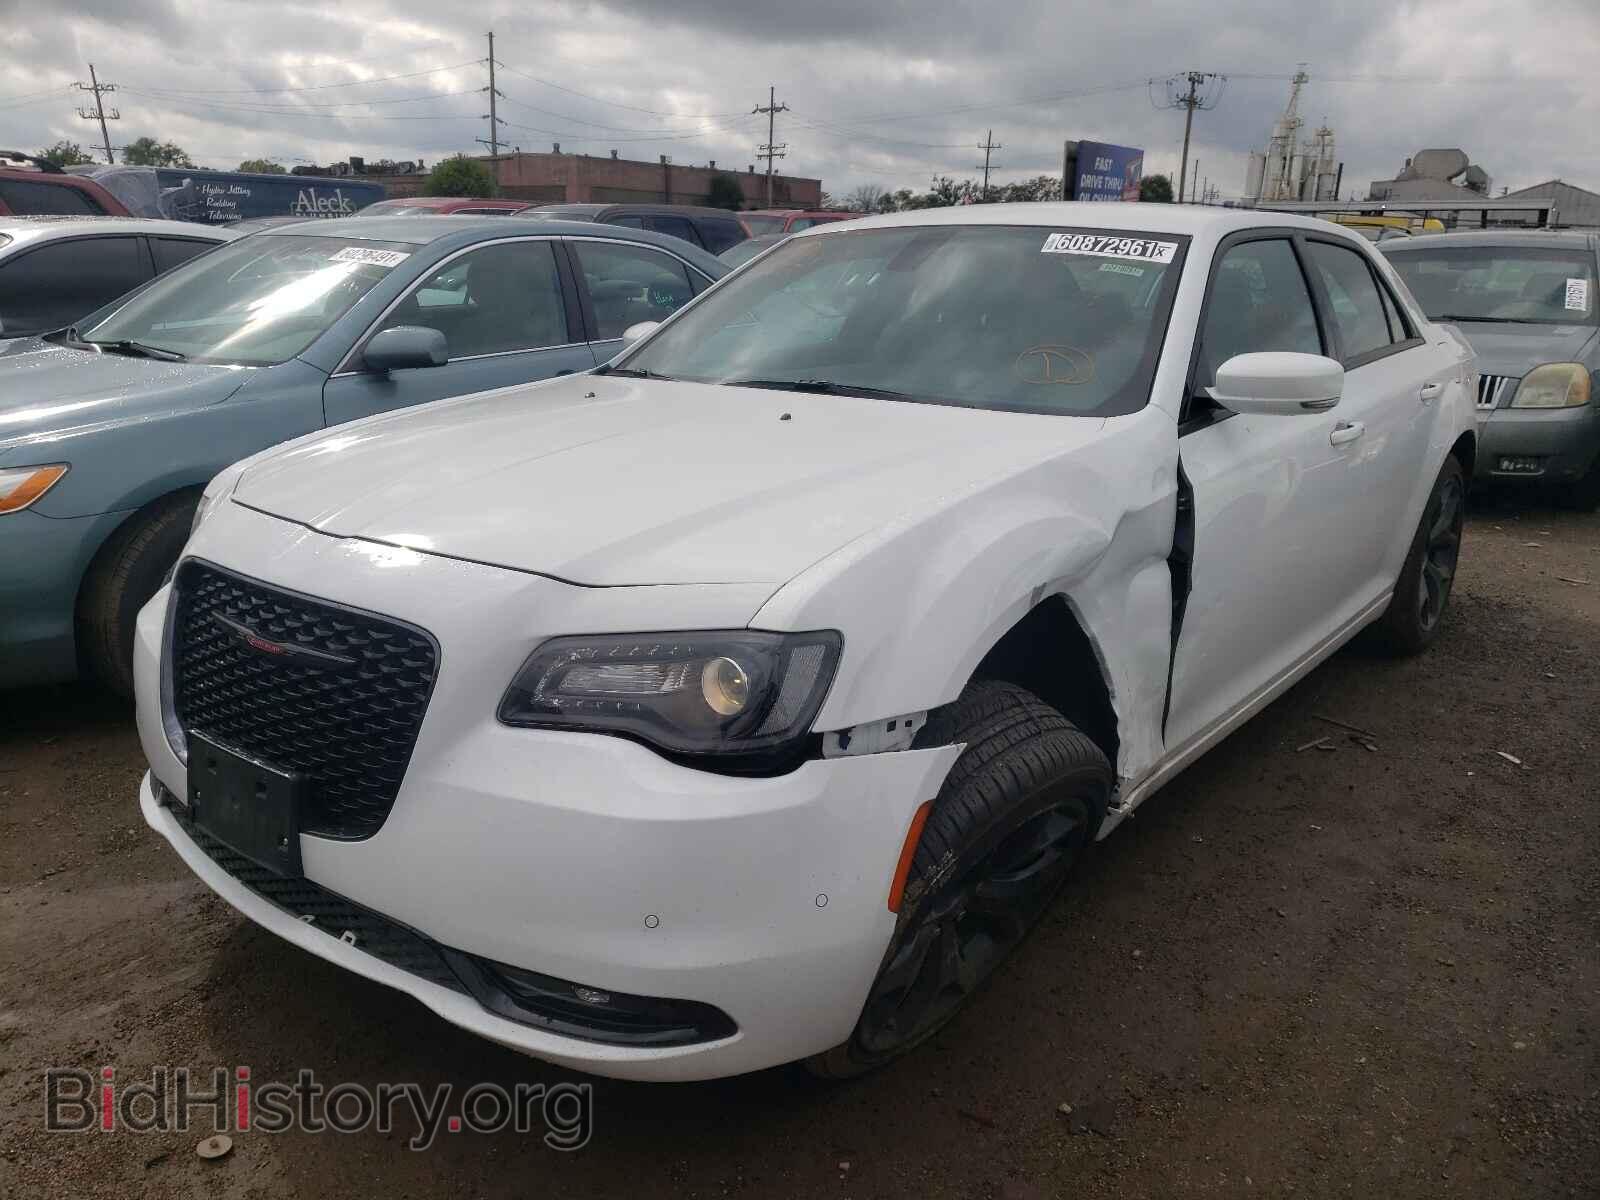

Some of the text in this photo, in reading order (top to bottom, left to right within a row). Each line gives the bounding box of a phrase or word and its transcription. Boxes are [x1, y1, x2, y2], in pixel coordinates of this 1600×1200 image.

[1094, 157, 1113, 171] FAST
[1080, 174, 1123, 191] DRIVE THRU
[295, 187, 353, 213] Aleck
[1055, 234, 1157, 258] 60872961
